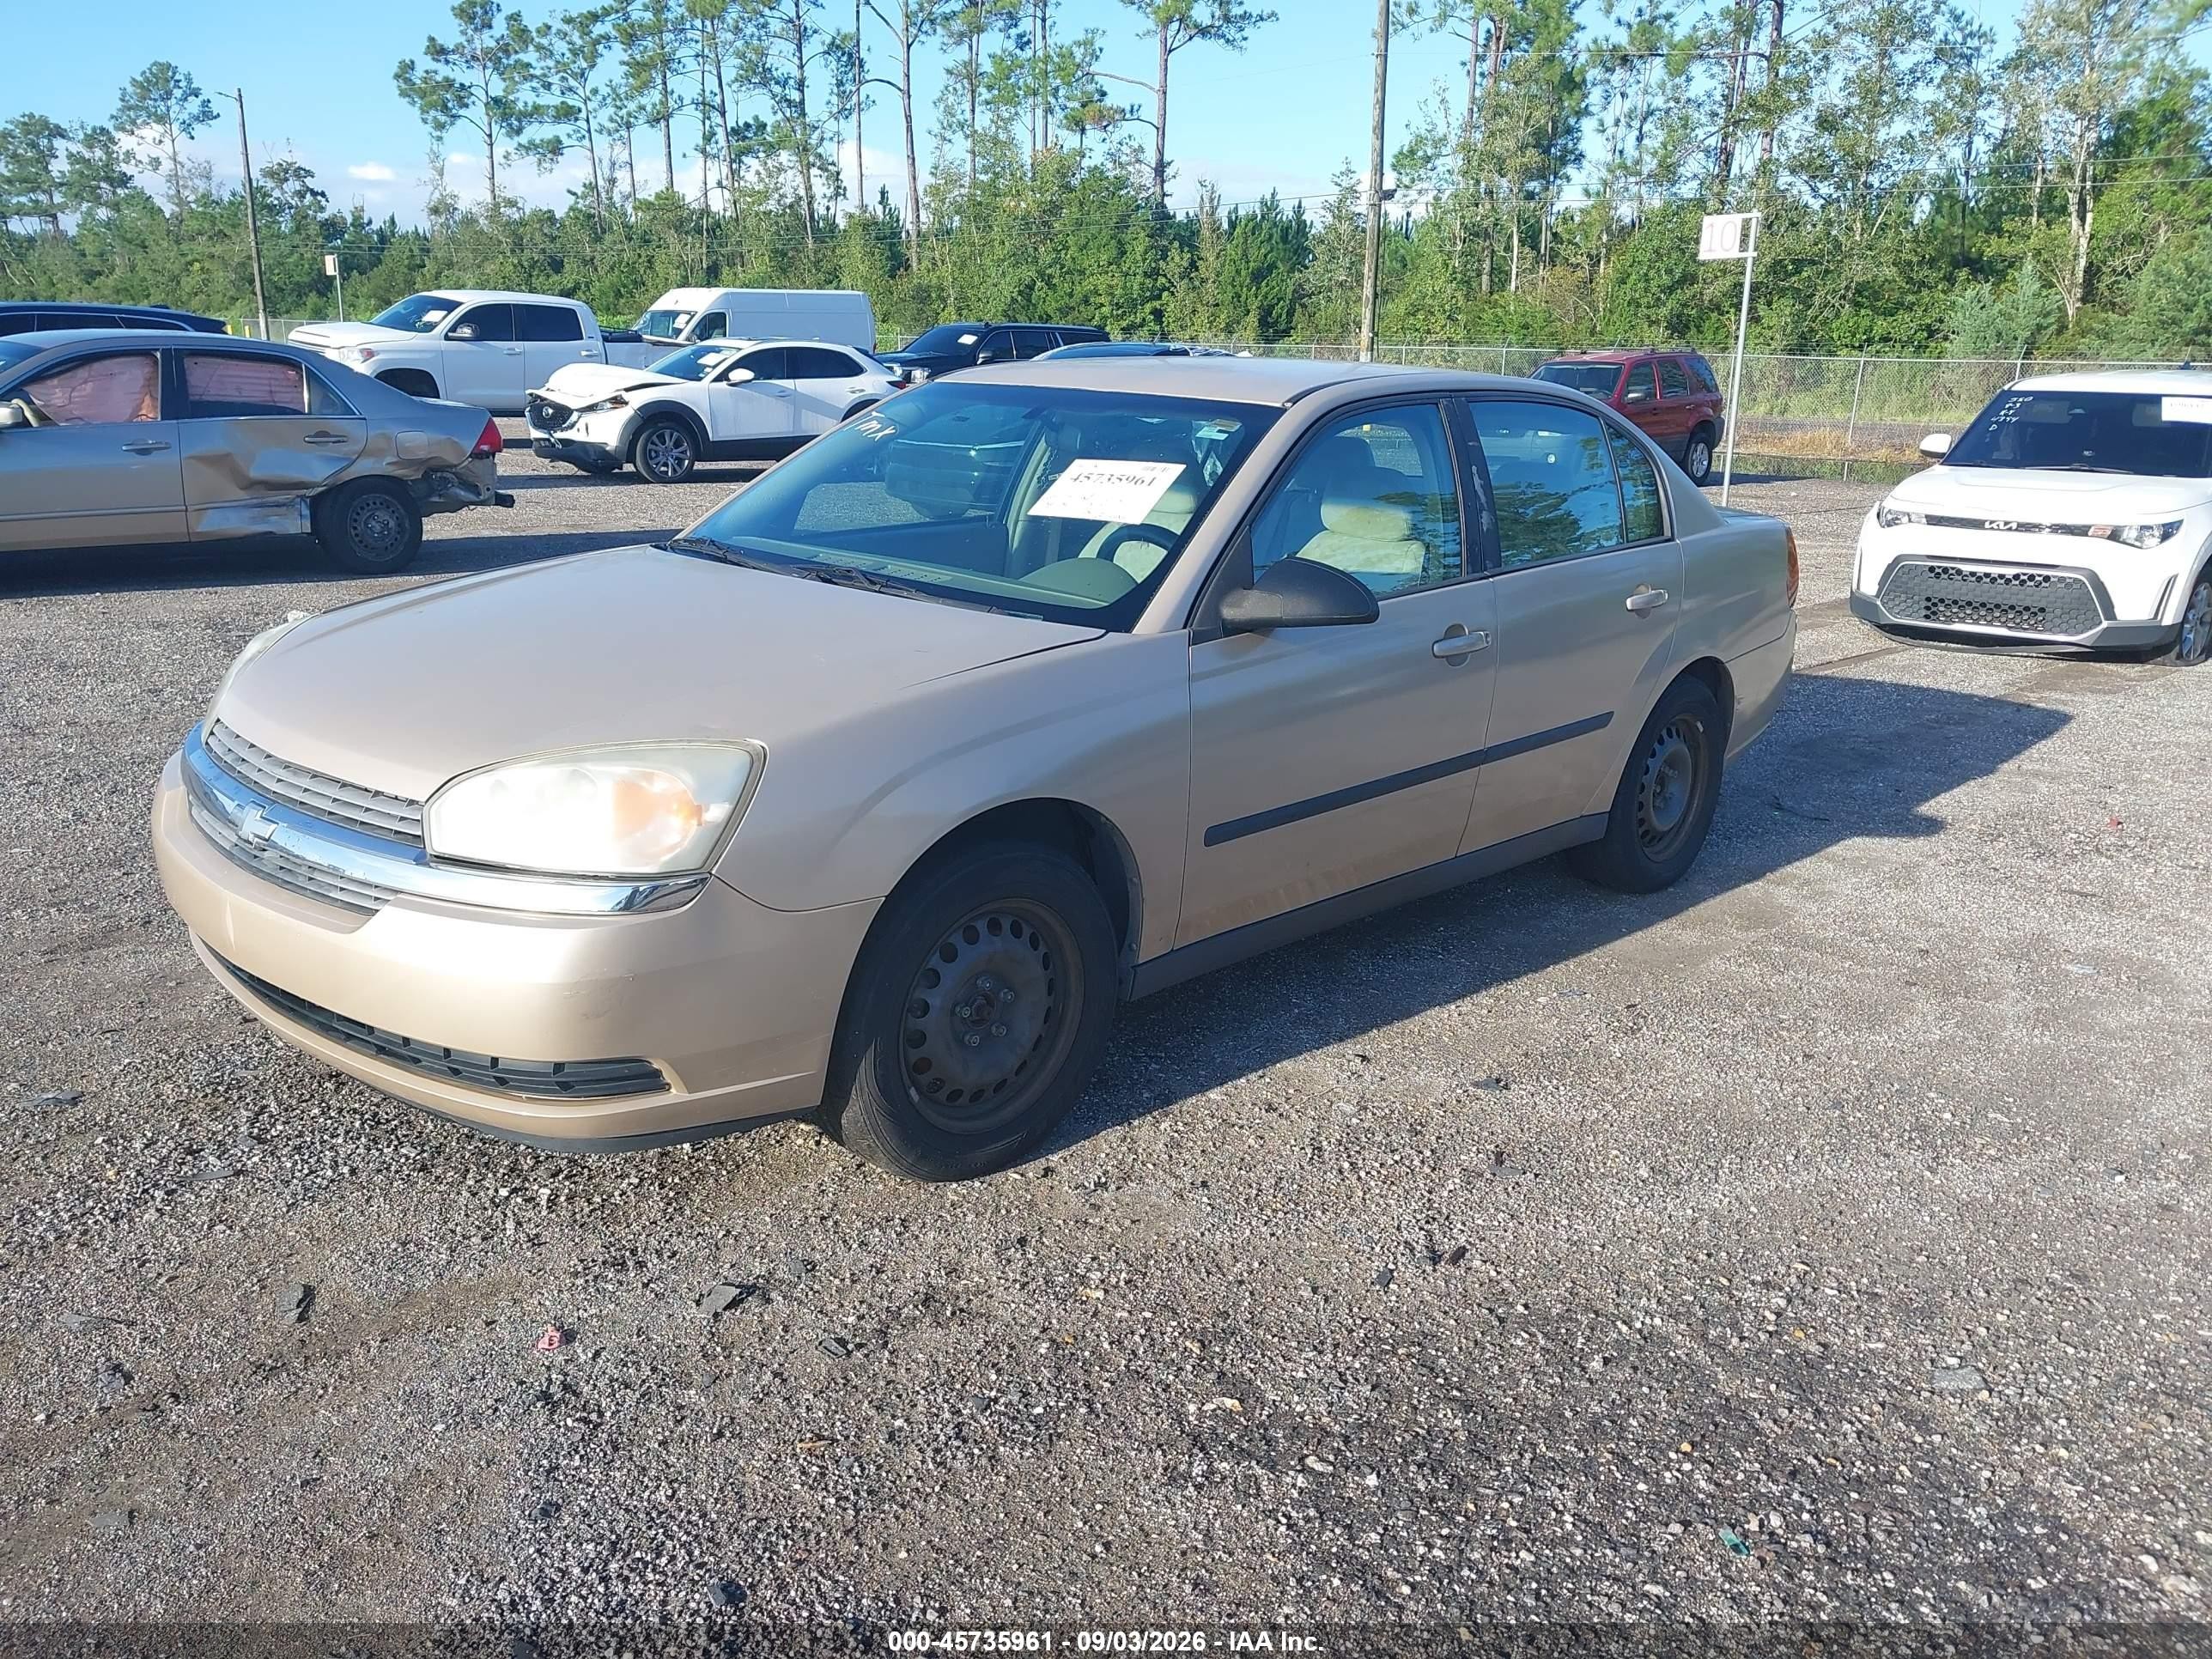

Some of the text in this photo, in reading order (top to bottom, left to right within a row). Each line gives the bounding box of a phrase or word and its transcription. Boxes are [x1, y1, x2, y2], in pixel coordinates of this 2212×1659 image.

[1703, 219, 1737, 252] 10
[1070, 472, 1157, 487] 45735961
[1984, 520, 2018, 531] KIA
